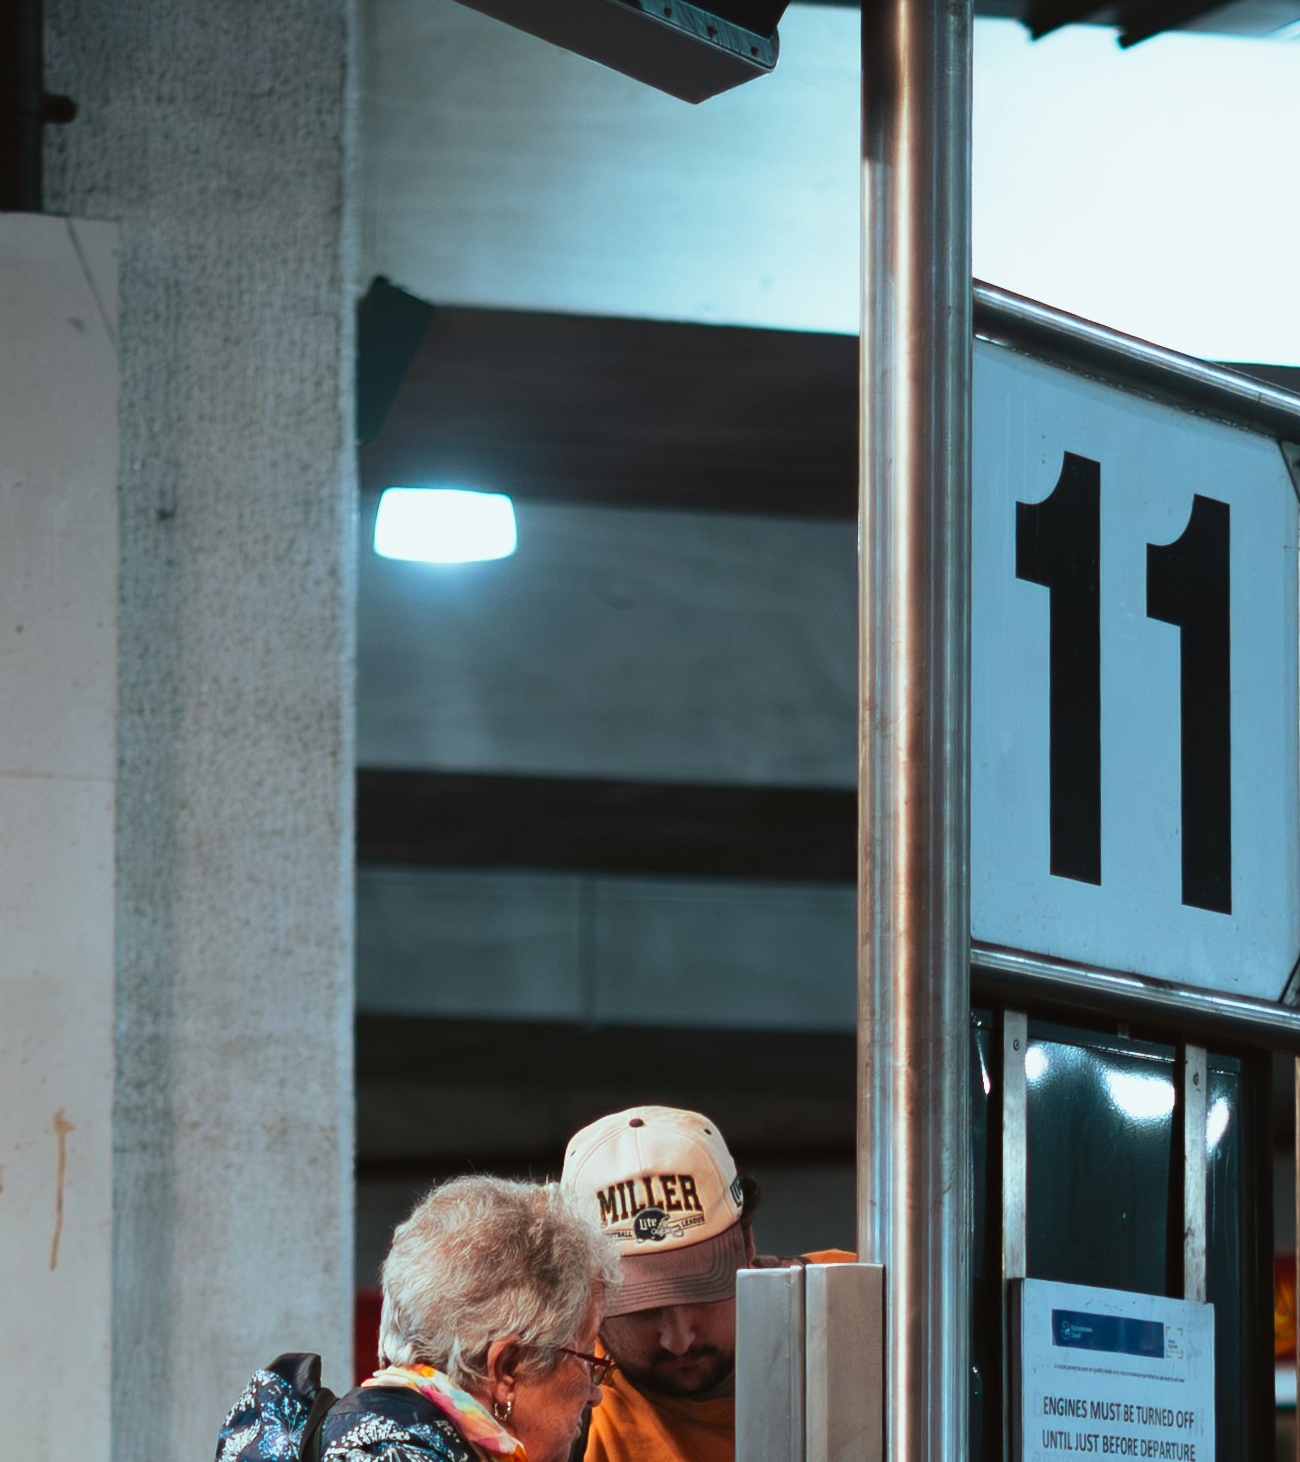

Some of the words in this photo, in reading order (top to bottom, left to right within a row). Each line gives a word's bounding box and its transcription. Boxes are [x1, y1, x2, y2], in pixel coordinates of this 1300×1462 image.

[1015, 450, 1231, 915] 11
[597, 1173, 703, 1224] MILLER
[639, 1218, 658, 1230] Lite
[1043, 1396, 1087, 1418] ENGINES
[1090, 1401, 1121, 1421] MUST
[1124, 1404, 1134, 1423] BE
[1136, 1406, 1174, 1427] TURNED
[1176, 1410, 1194, 1429] OFF
[1042, 1429, 1073, 1450] UNTIL
[1075, 1433, 1100, 1453] JUST
[1102, 1435, 1138, 1456] BEFORE
[1141, 1439, 1196, 1462] DEPARTURE
